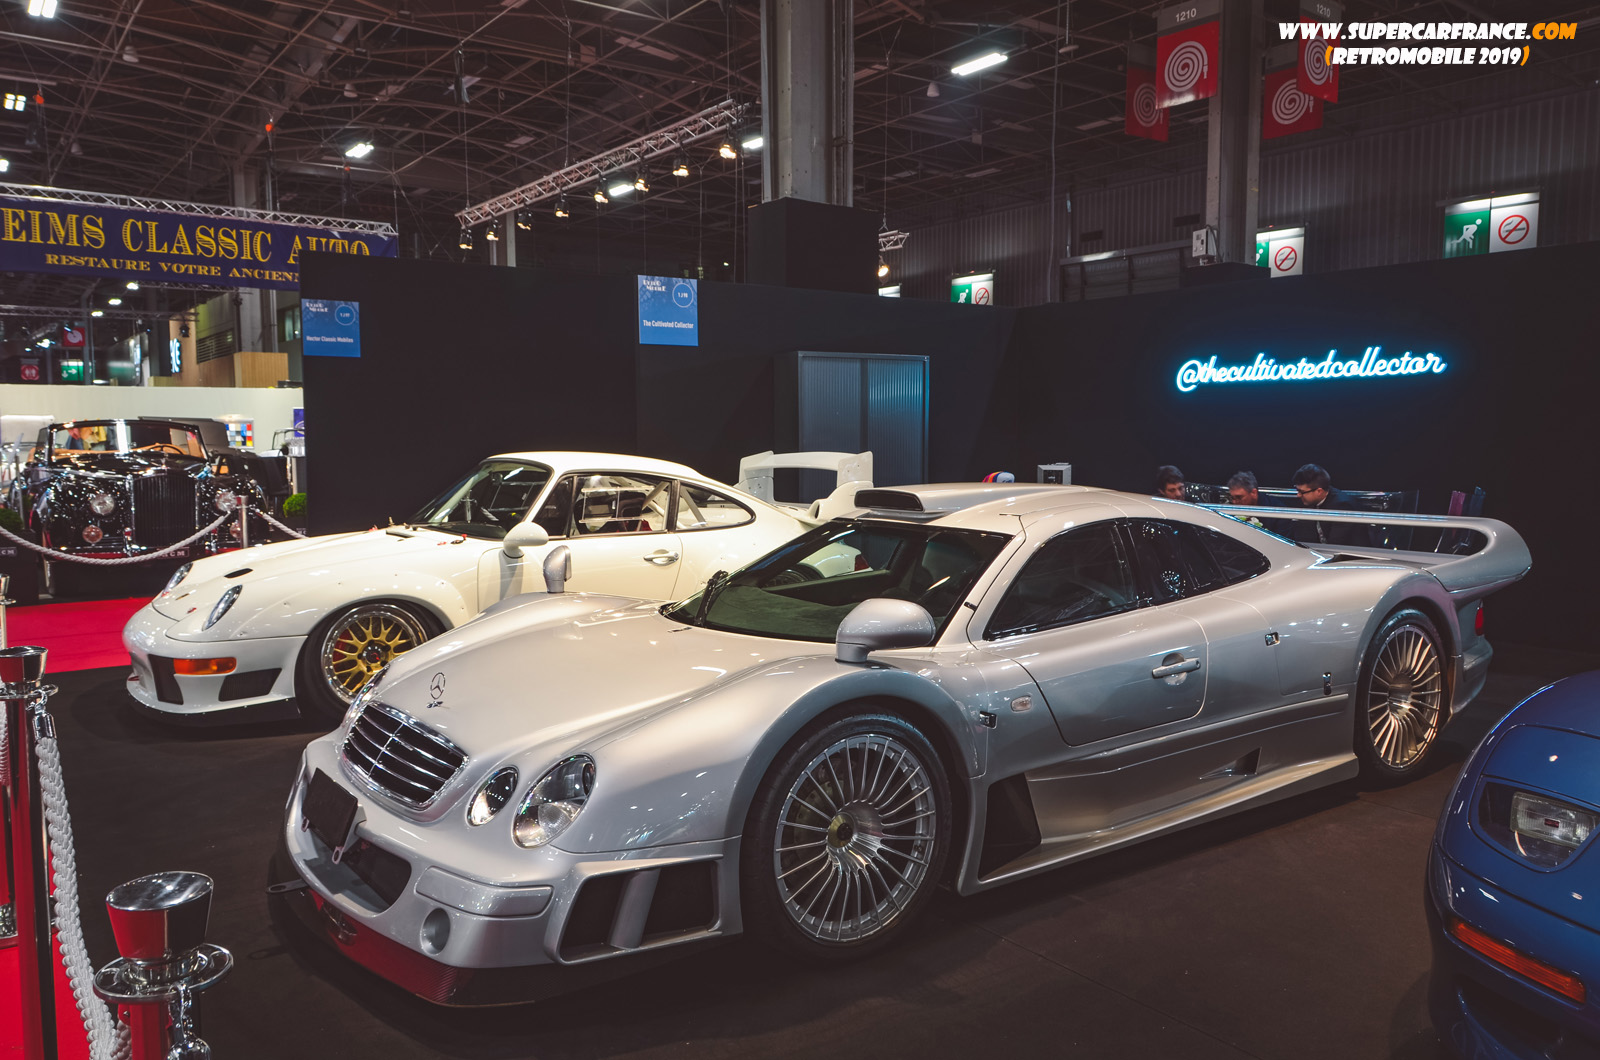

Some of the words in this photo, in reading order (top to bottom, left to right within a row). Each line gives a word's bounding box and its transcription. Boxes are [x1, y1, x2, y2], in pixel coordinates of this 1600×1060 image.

[1175, 8, 1197, 23] 1210
[1316, 3, 1331, 18] 1210
[122, 219, 272, 262] CLASSIC
[45, 253, 151, 271] RESTAURE
[158, 261, 221, 276] VOTRE
[228, 267, 299, 282] ANCIEN
[674, 321, 694, 329] Collector
[1176, 346, 1448, 392] @thecultivatedcollector
